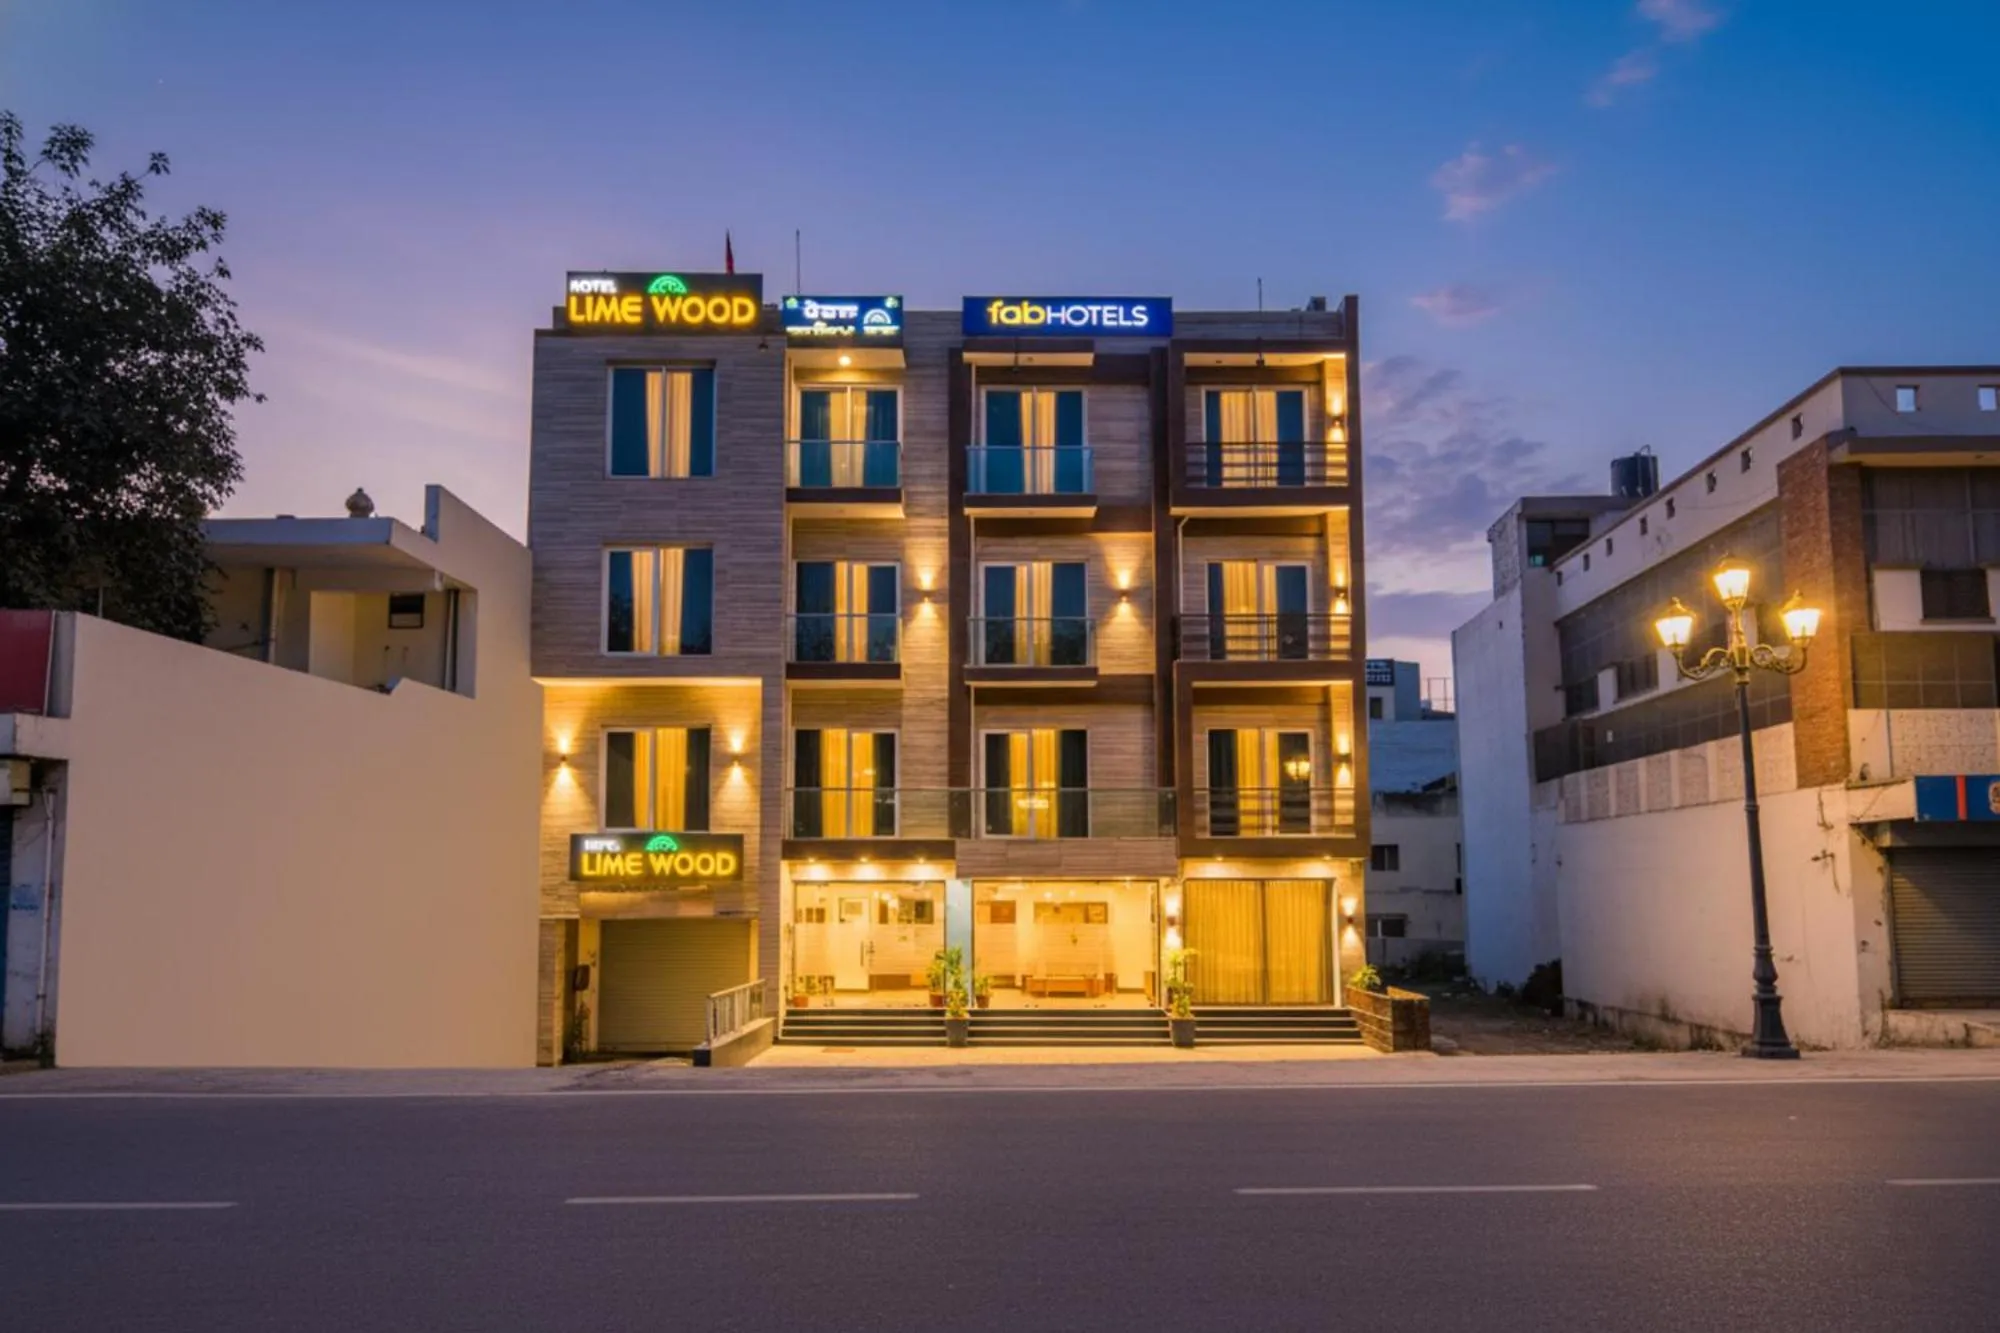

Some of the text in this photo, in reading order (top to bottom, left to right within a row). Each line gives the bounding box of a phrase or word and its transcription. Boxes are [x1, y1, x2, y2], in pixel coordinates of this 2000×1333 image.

[569, 295, 756, 324] LIME WOOD
[987, 300, 1149, 326] fabHOTELS
[582, 853, 737, 876] LIME WOOD
